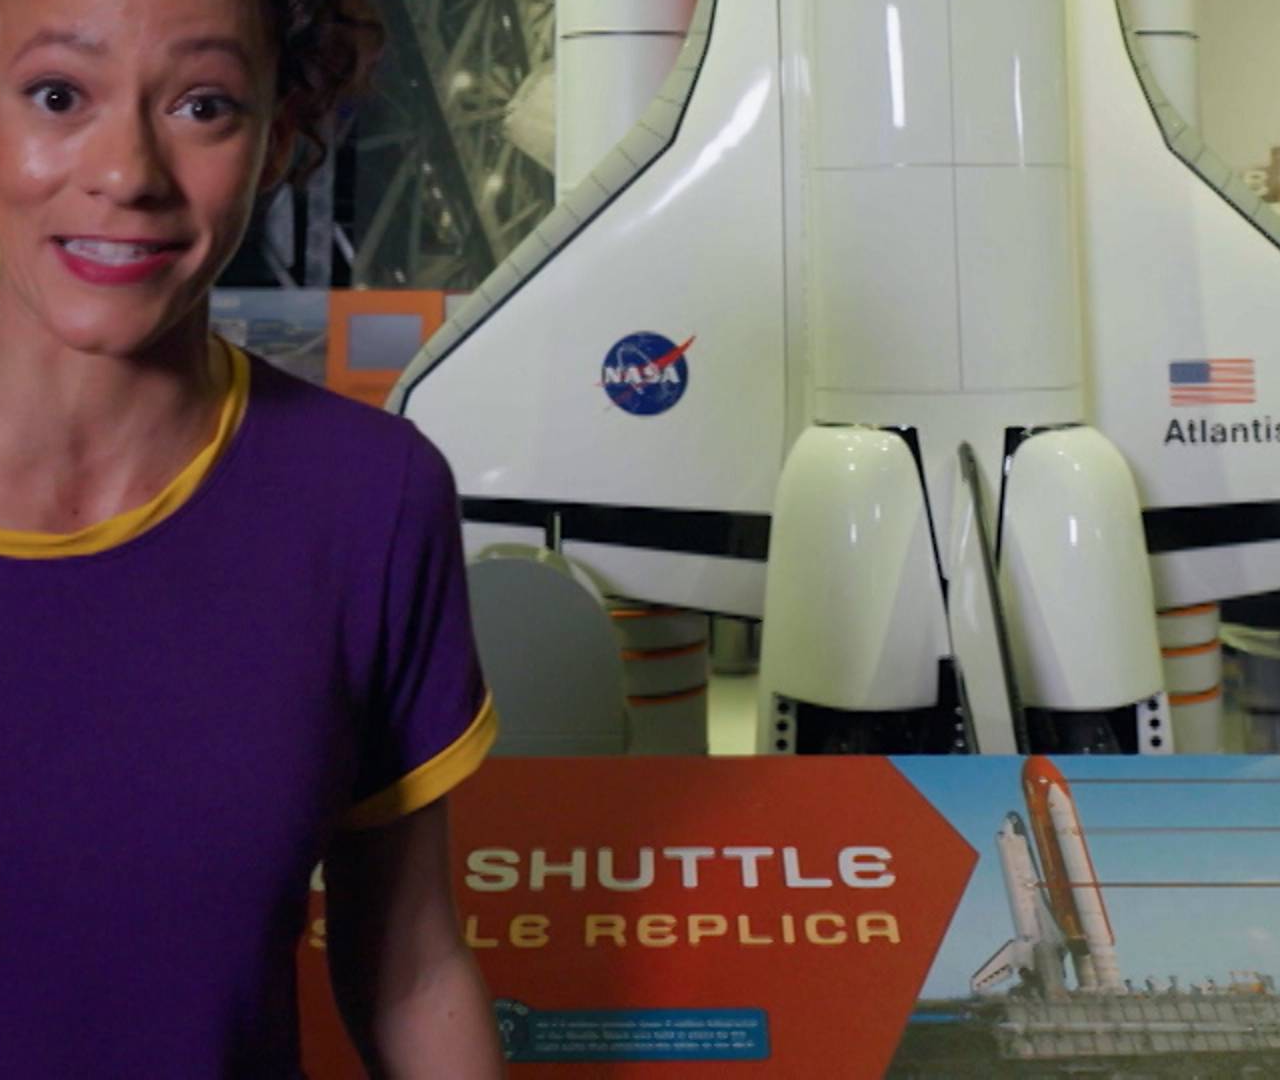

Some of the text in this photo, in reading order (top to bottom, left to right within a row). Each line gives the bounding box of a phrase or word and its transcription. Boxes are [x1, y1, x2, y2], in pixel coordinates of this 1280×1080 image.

[603, 363, 681, 385] NASA
[464, 845, 897, 893] SHUTTLE
[583, 912, 903, 949] REPLICA
